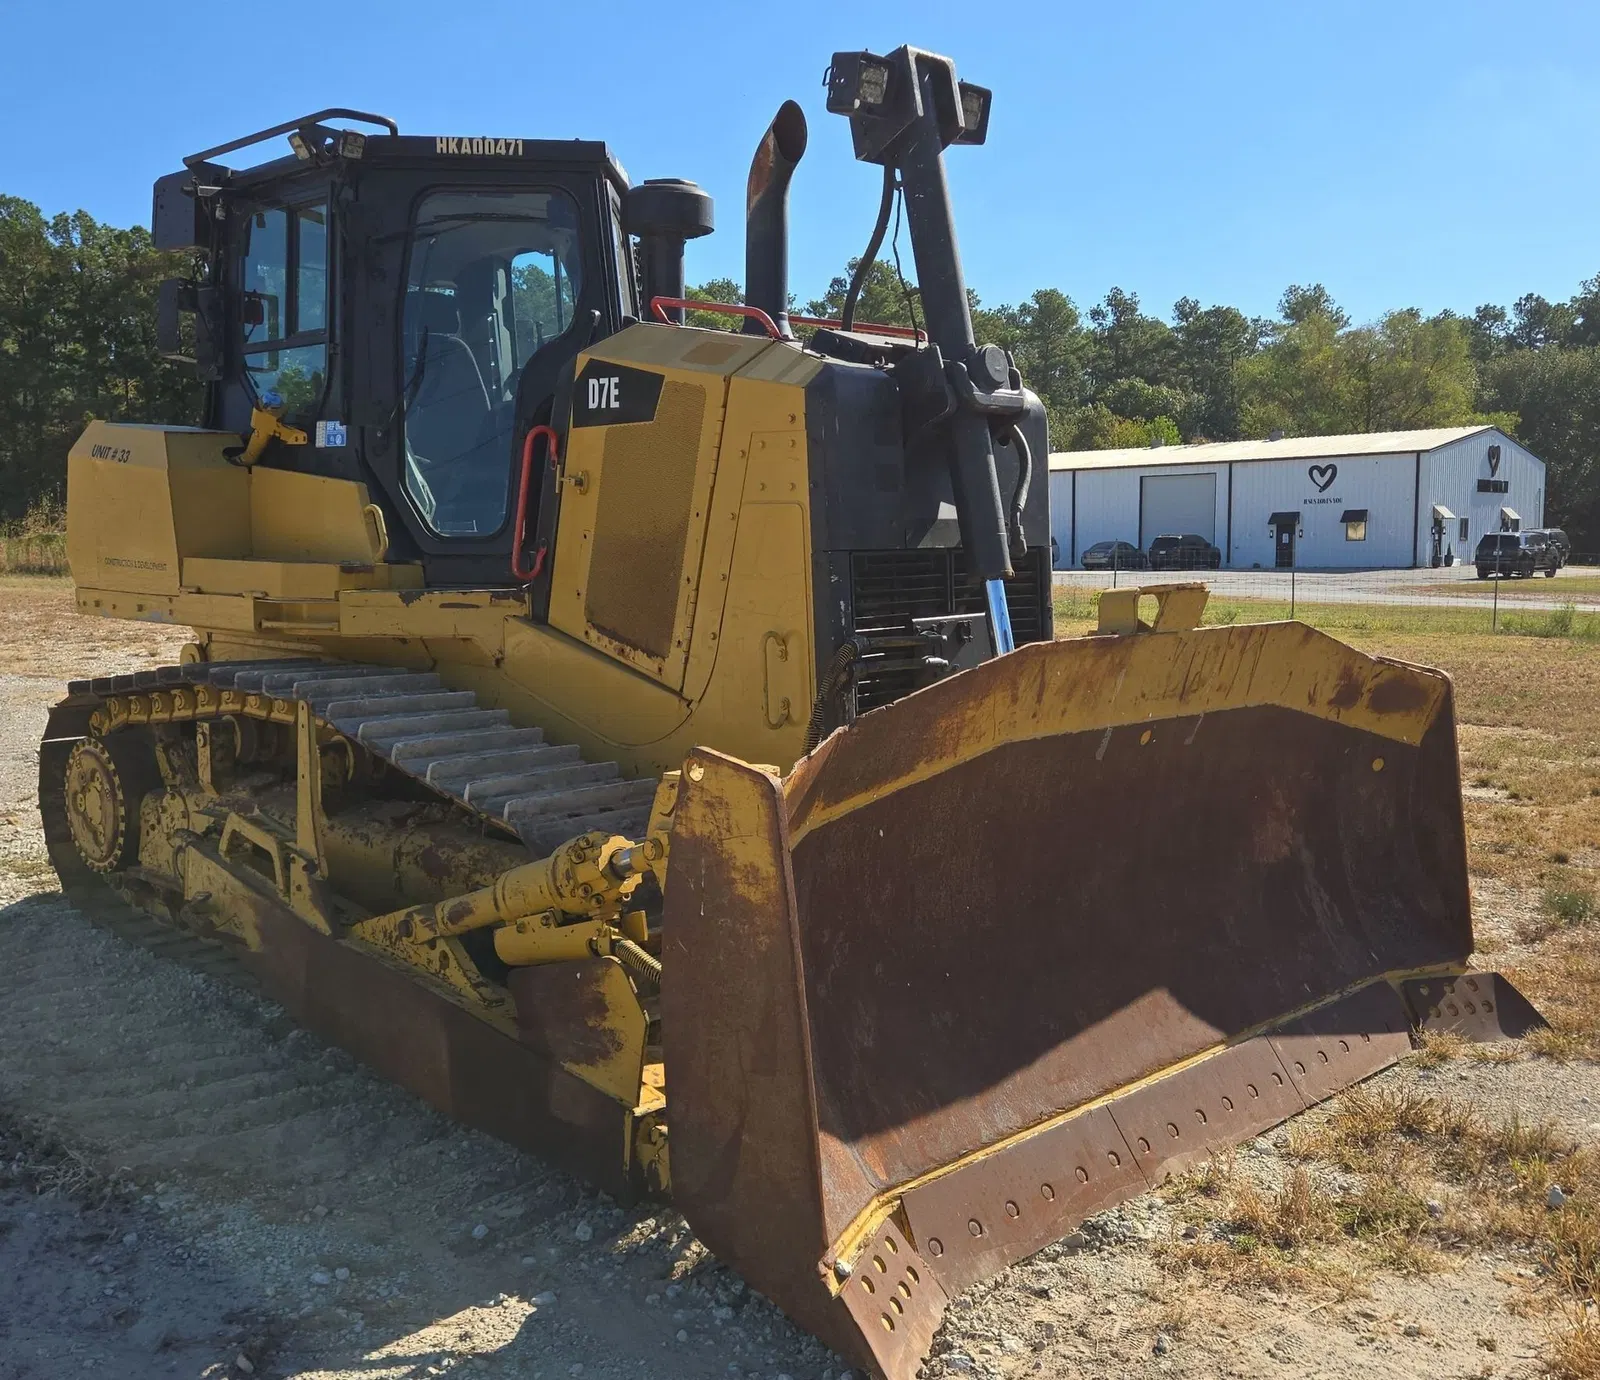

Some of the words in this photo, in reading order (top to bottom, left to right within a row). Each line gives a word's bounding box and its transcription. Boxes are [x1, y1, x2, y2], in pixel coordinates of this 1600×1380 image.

[436, 137, 523, 156] HKA00471
[588, 376, 620, 409] D7E
[91, 444, 112, 460] UNIT
[111, 448, 119, 460] #
[118, 449, 131, 463] 33
